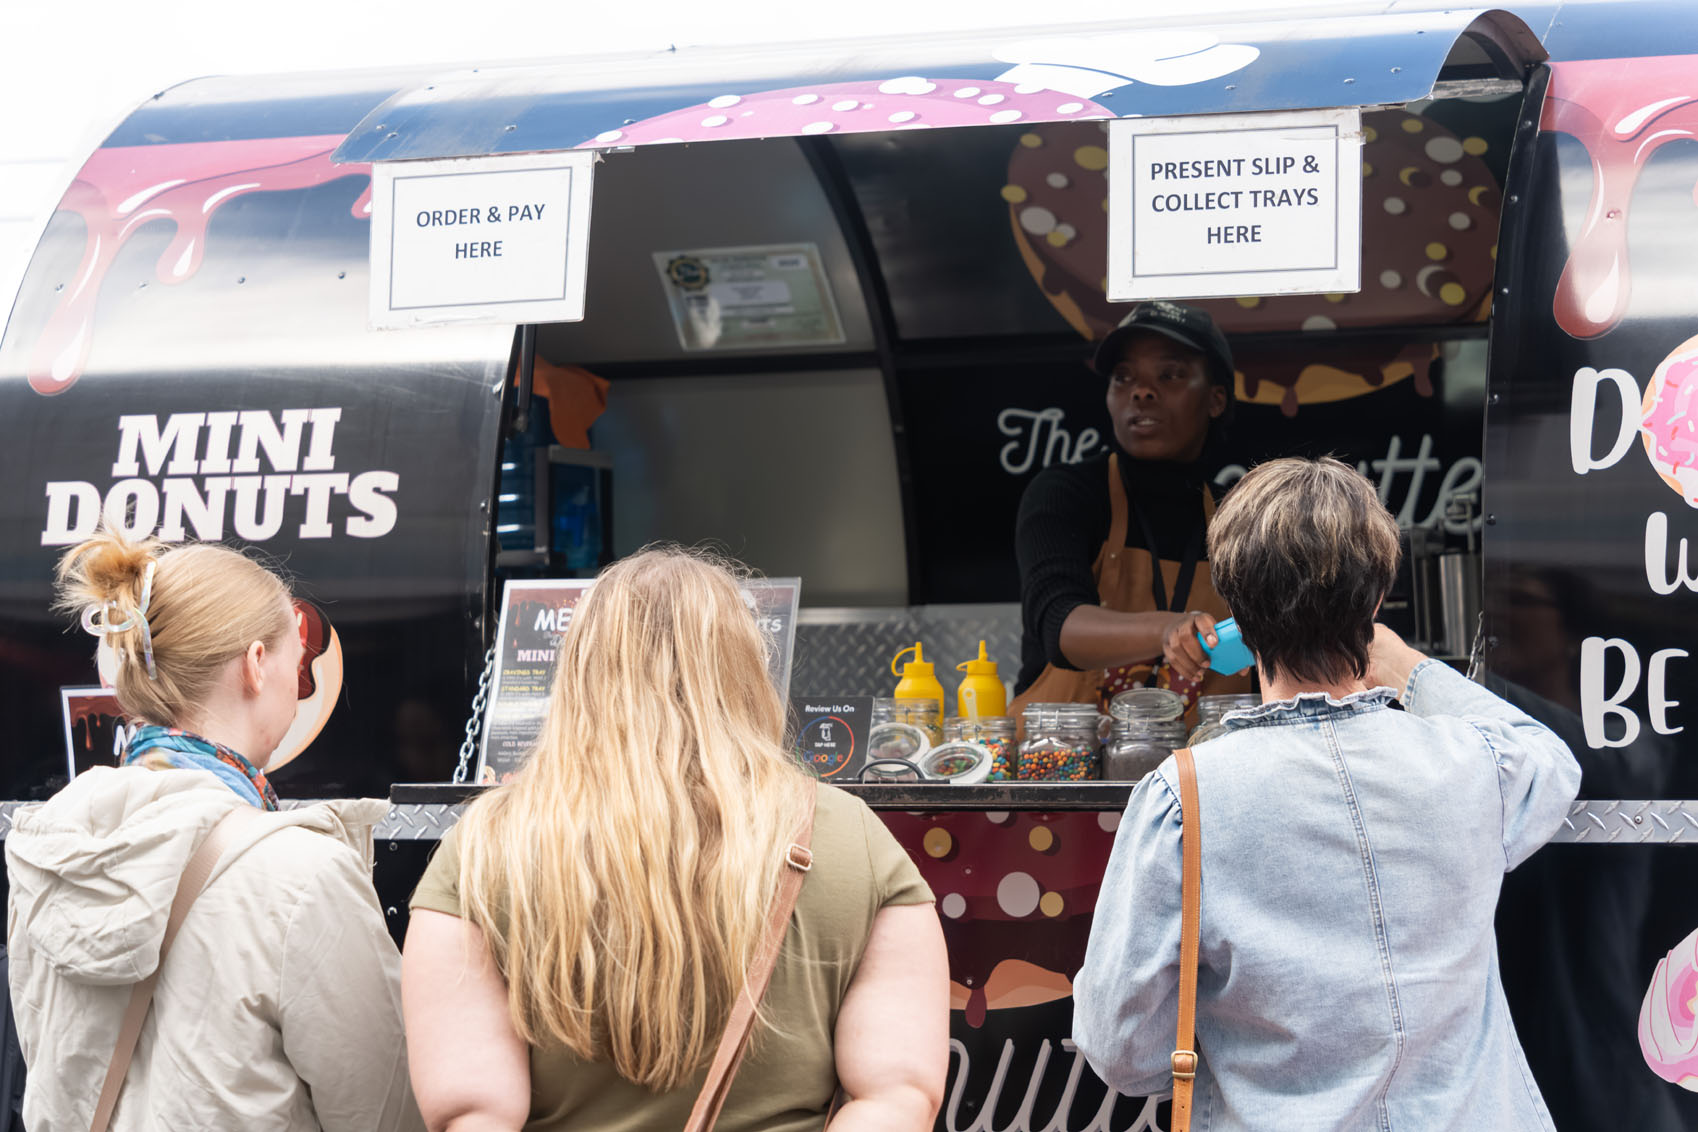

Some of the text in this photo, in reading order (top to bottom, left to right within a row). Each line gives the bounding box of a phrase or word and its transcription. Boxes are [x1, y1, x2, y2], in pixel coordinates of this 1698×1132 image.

[1151, 155, 1320, 180] PRESENT SLIP &
[1151, 187, 1319, 213] COLLECT TRAYS
[416, 203, 546, 228] ORDER & PAY
[1207, 225, 1262, 245] HERE
[455, 240, 503, 259] HERE
[111, 407, 342, 478] MINI
[997, 407, 1100, 475] The
[40, 470, 400, 546] DONUTS
[534, 608, 574, 632] ME
[516, 649, 555, 662] MINI
[1580, 637, 1689, 749] BE
[805, 704, 855, 713] Review Us On
[803, 750, 844, 766] Google
